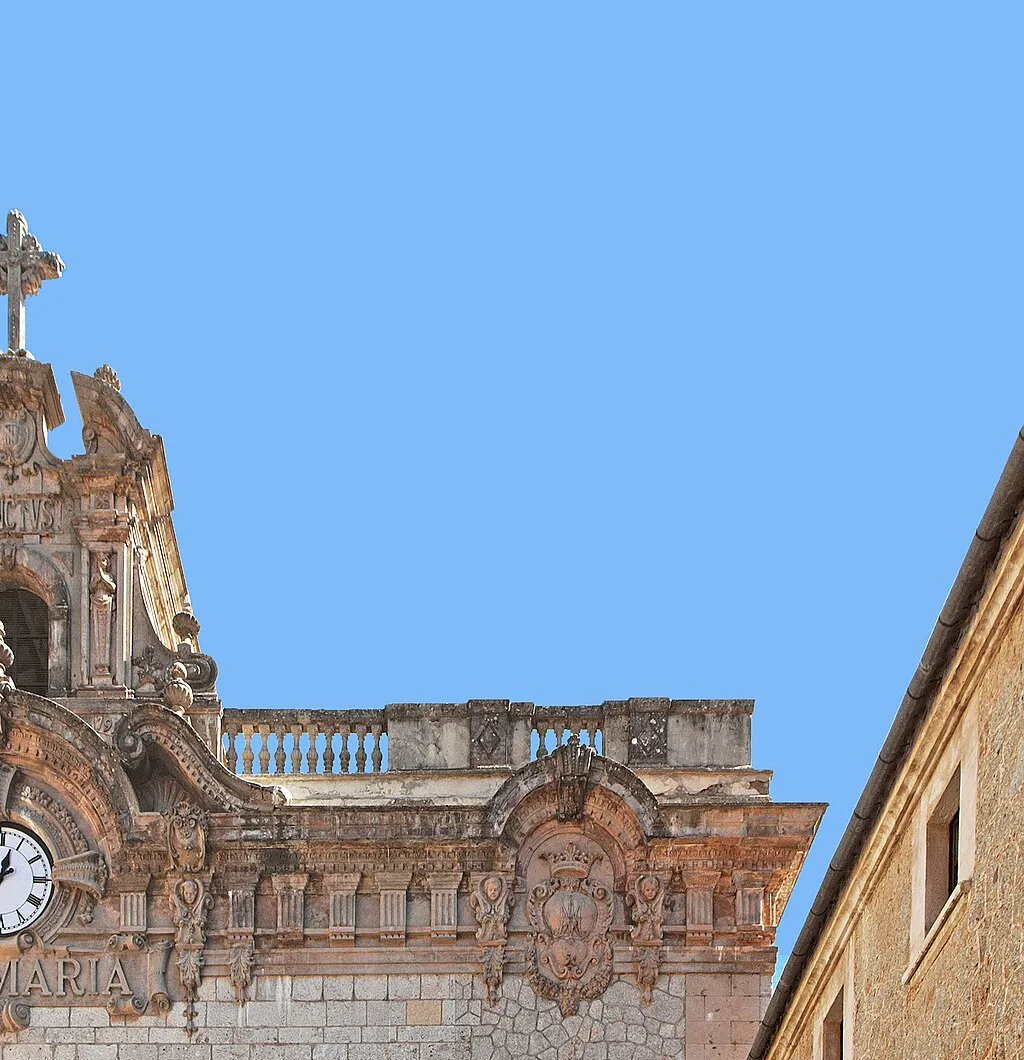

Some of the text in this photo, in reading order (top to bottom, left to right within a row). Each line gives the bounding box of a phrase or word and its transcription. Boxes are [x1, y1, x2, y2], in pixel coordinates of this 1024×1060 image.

[16, 837, 25, 851] I
[28, 854, 42, 865] II
[32, 876, 47, 884] III
[16, 909, 26, 924] V
